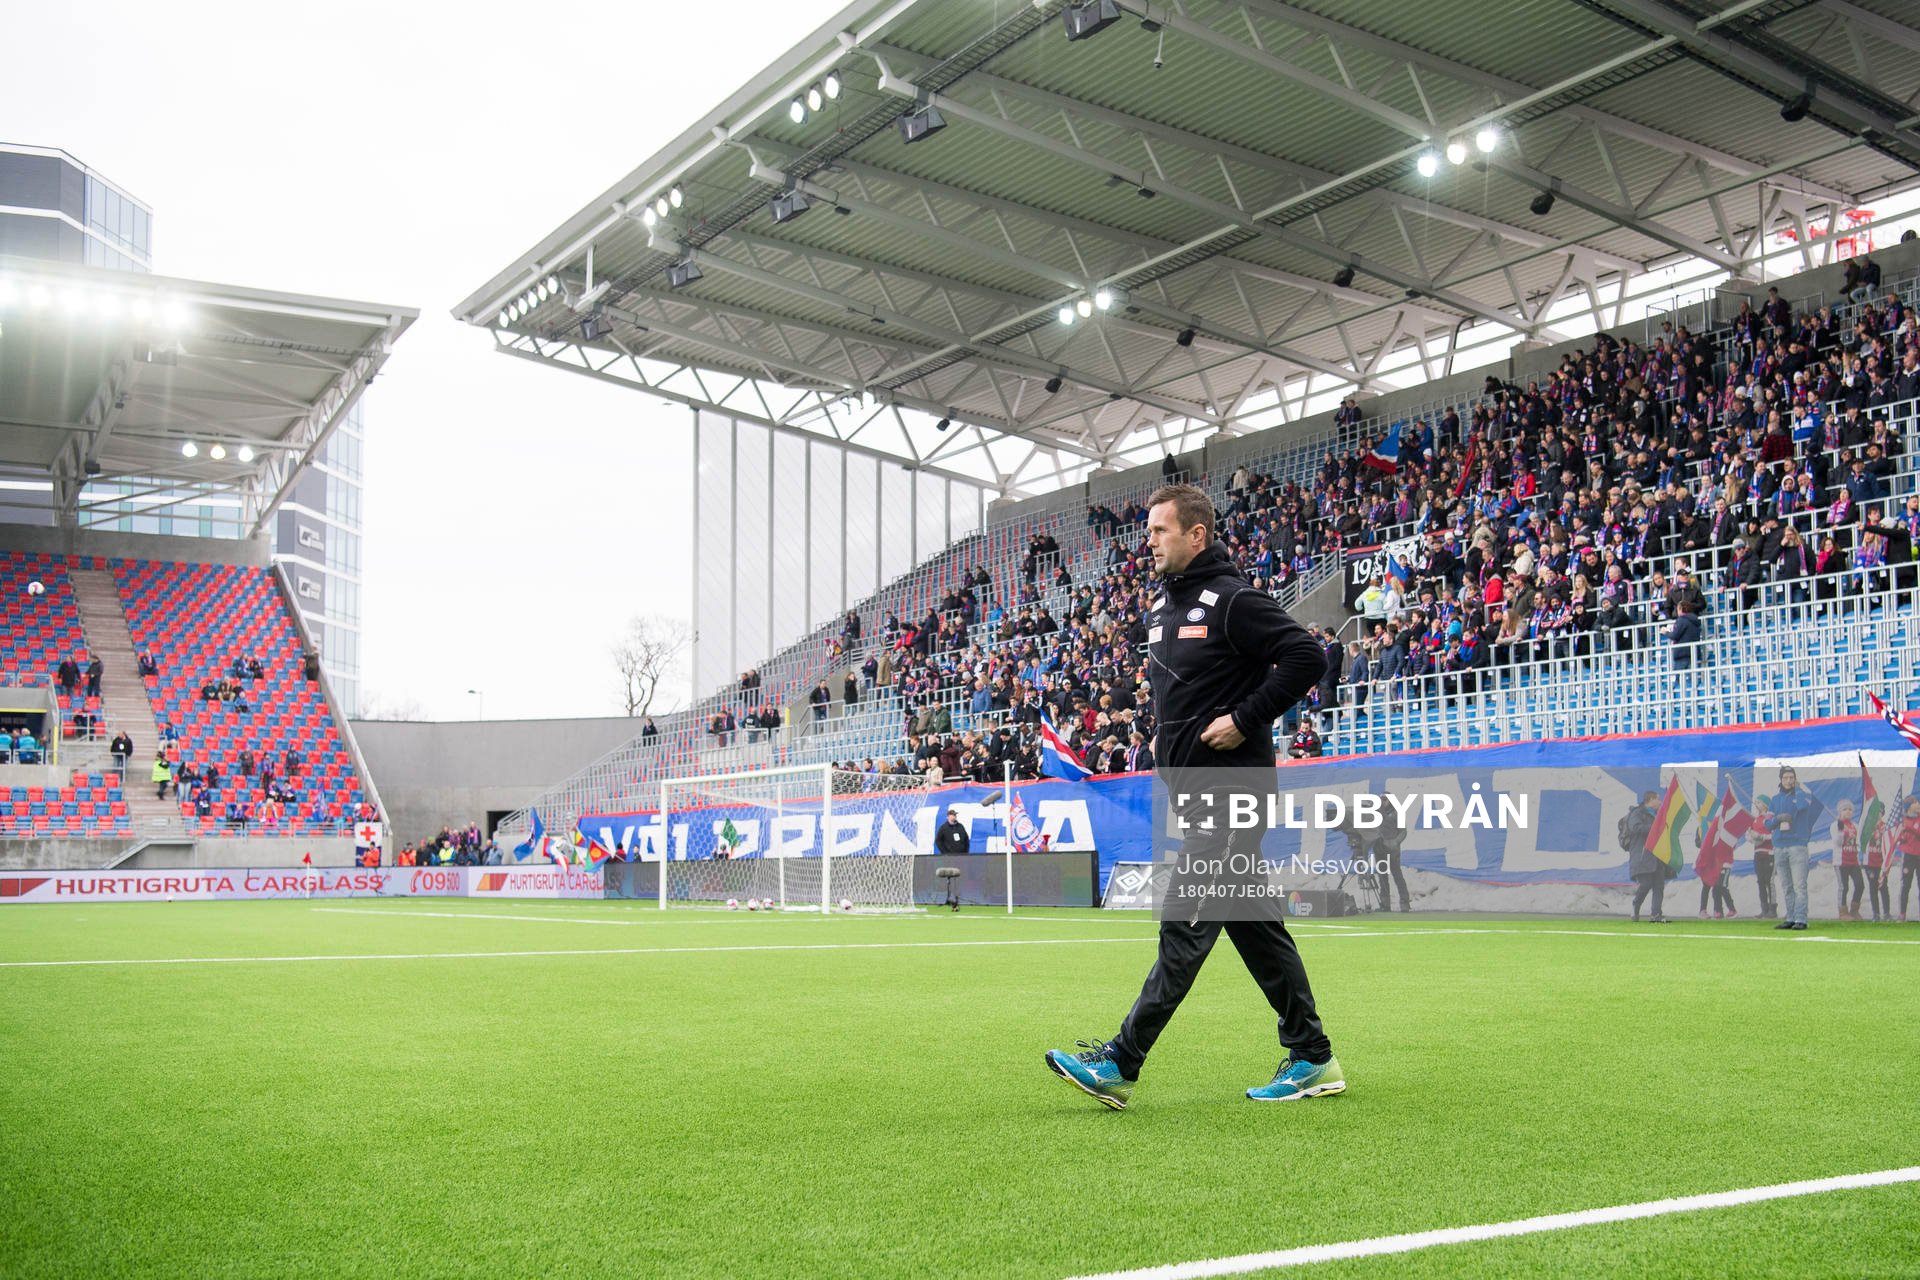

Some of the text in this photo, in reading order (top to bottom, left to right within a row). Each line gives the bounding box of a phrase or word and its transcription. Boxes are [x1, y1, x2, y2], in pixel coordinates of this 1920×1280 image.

[56, 874, 384, 894] HURTIGRUTA CARGLASS
[510, 872, 565, 891] HURTIGRUTA
[1295, 903, 1313, 916] NEP
